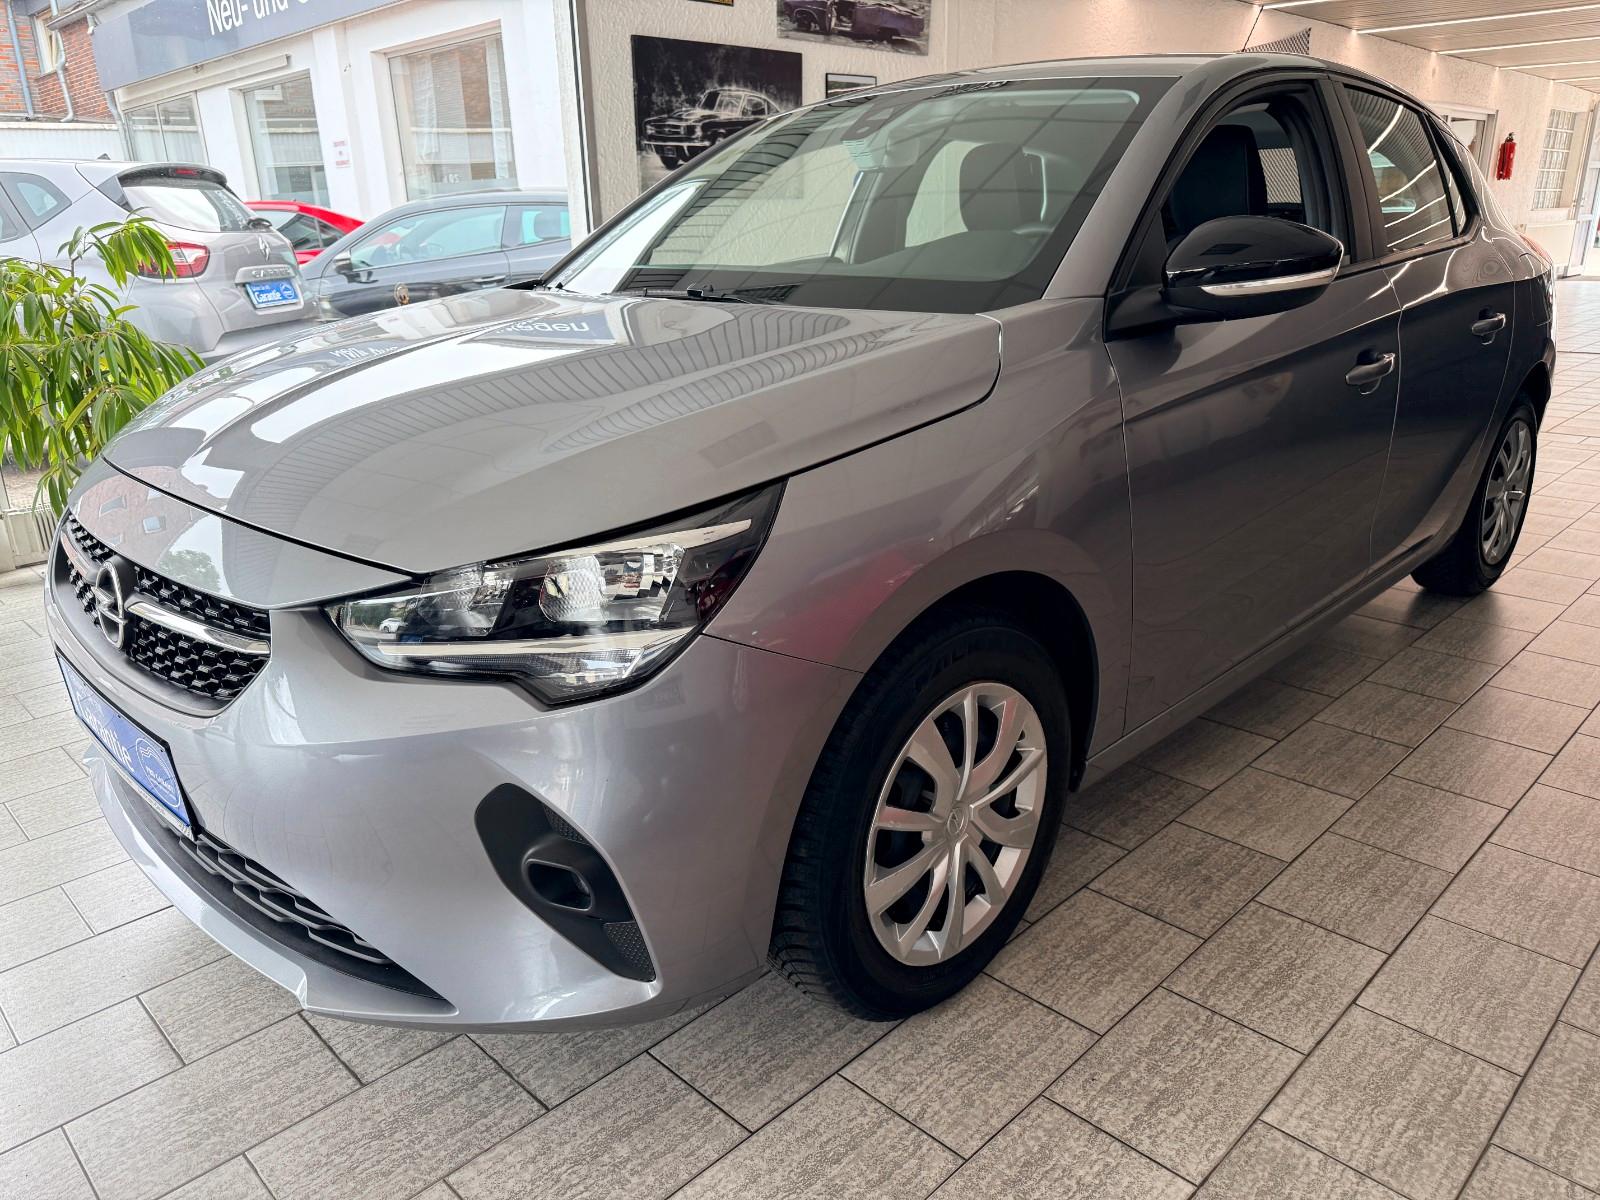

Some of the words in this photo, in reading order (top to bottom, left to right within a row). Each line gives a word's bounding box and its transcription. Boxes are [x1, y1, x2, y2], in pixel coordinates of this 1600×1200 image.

[206, 0, 248, 36] Neu-
[254, 290, 282, 302] Garantie
[75, 691, 136, 773] Garantie
